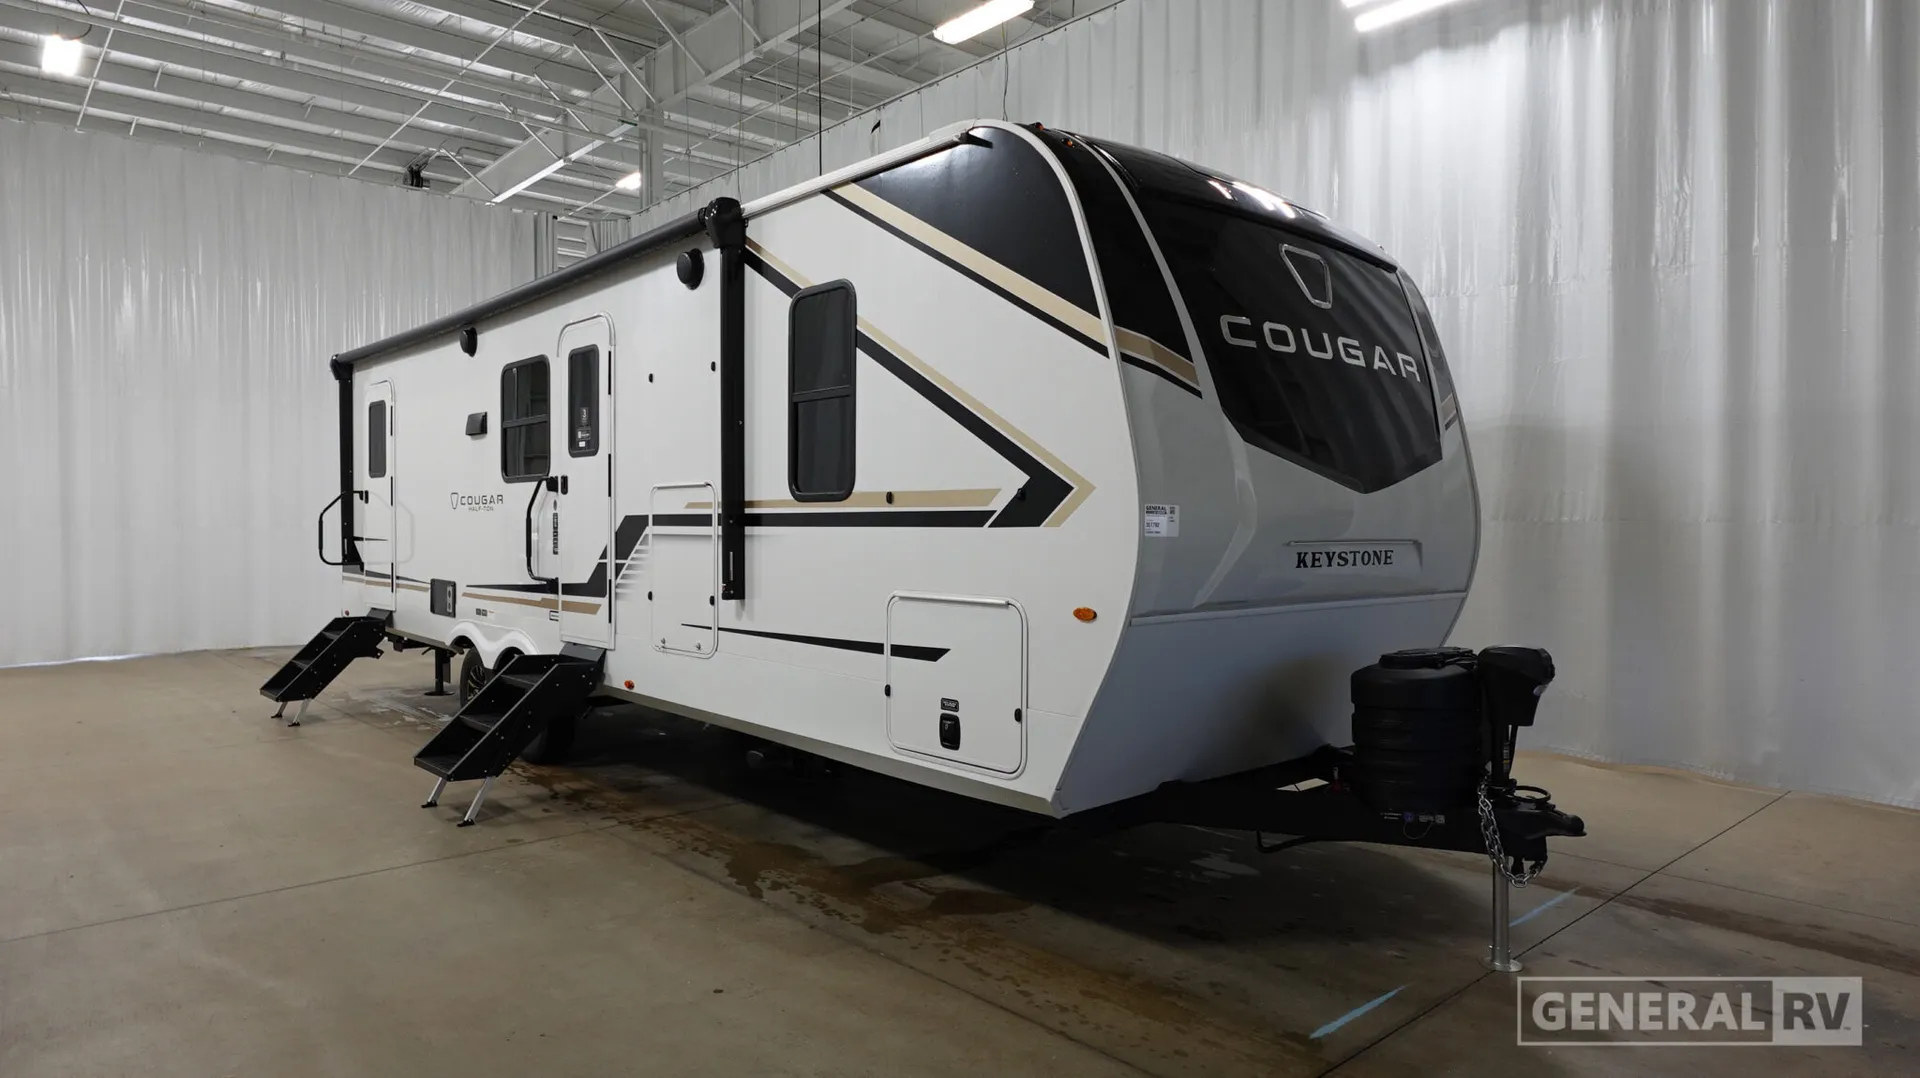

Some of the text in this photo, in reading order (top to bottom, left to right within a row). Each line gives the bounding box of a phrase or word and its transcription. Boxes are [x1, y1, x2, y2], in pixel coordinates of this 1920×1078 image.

[1220, 314, 1421, 383] COUGAR
[460, 494, 504, 506] COUGAR
[1295, 550, 1394, 568] KEYSTONE
